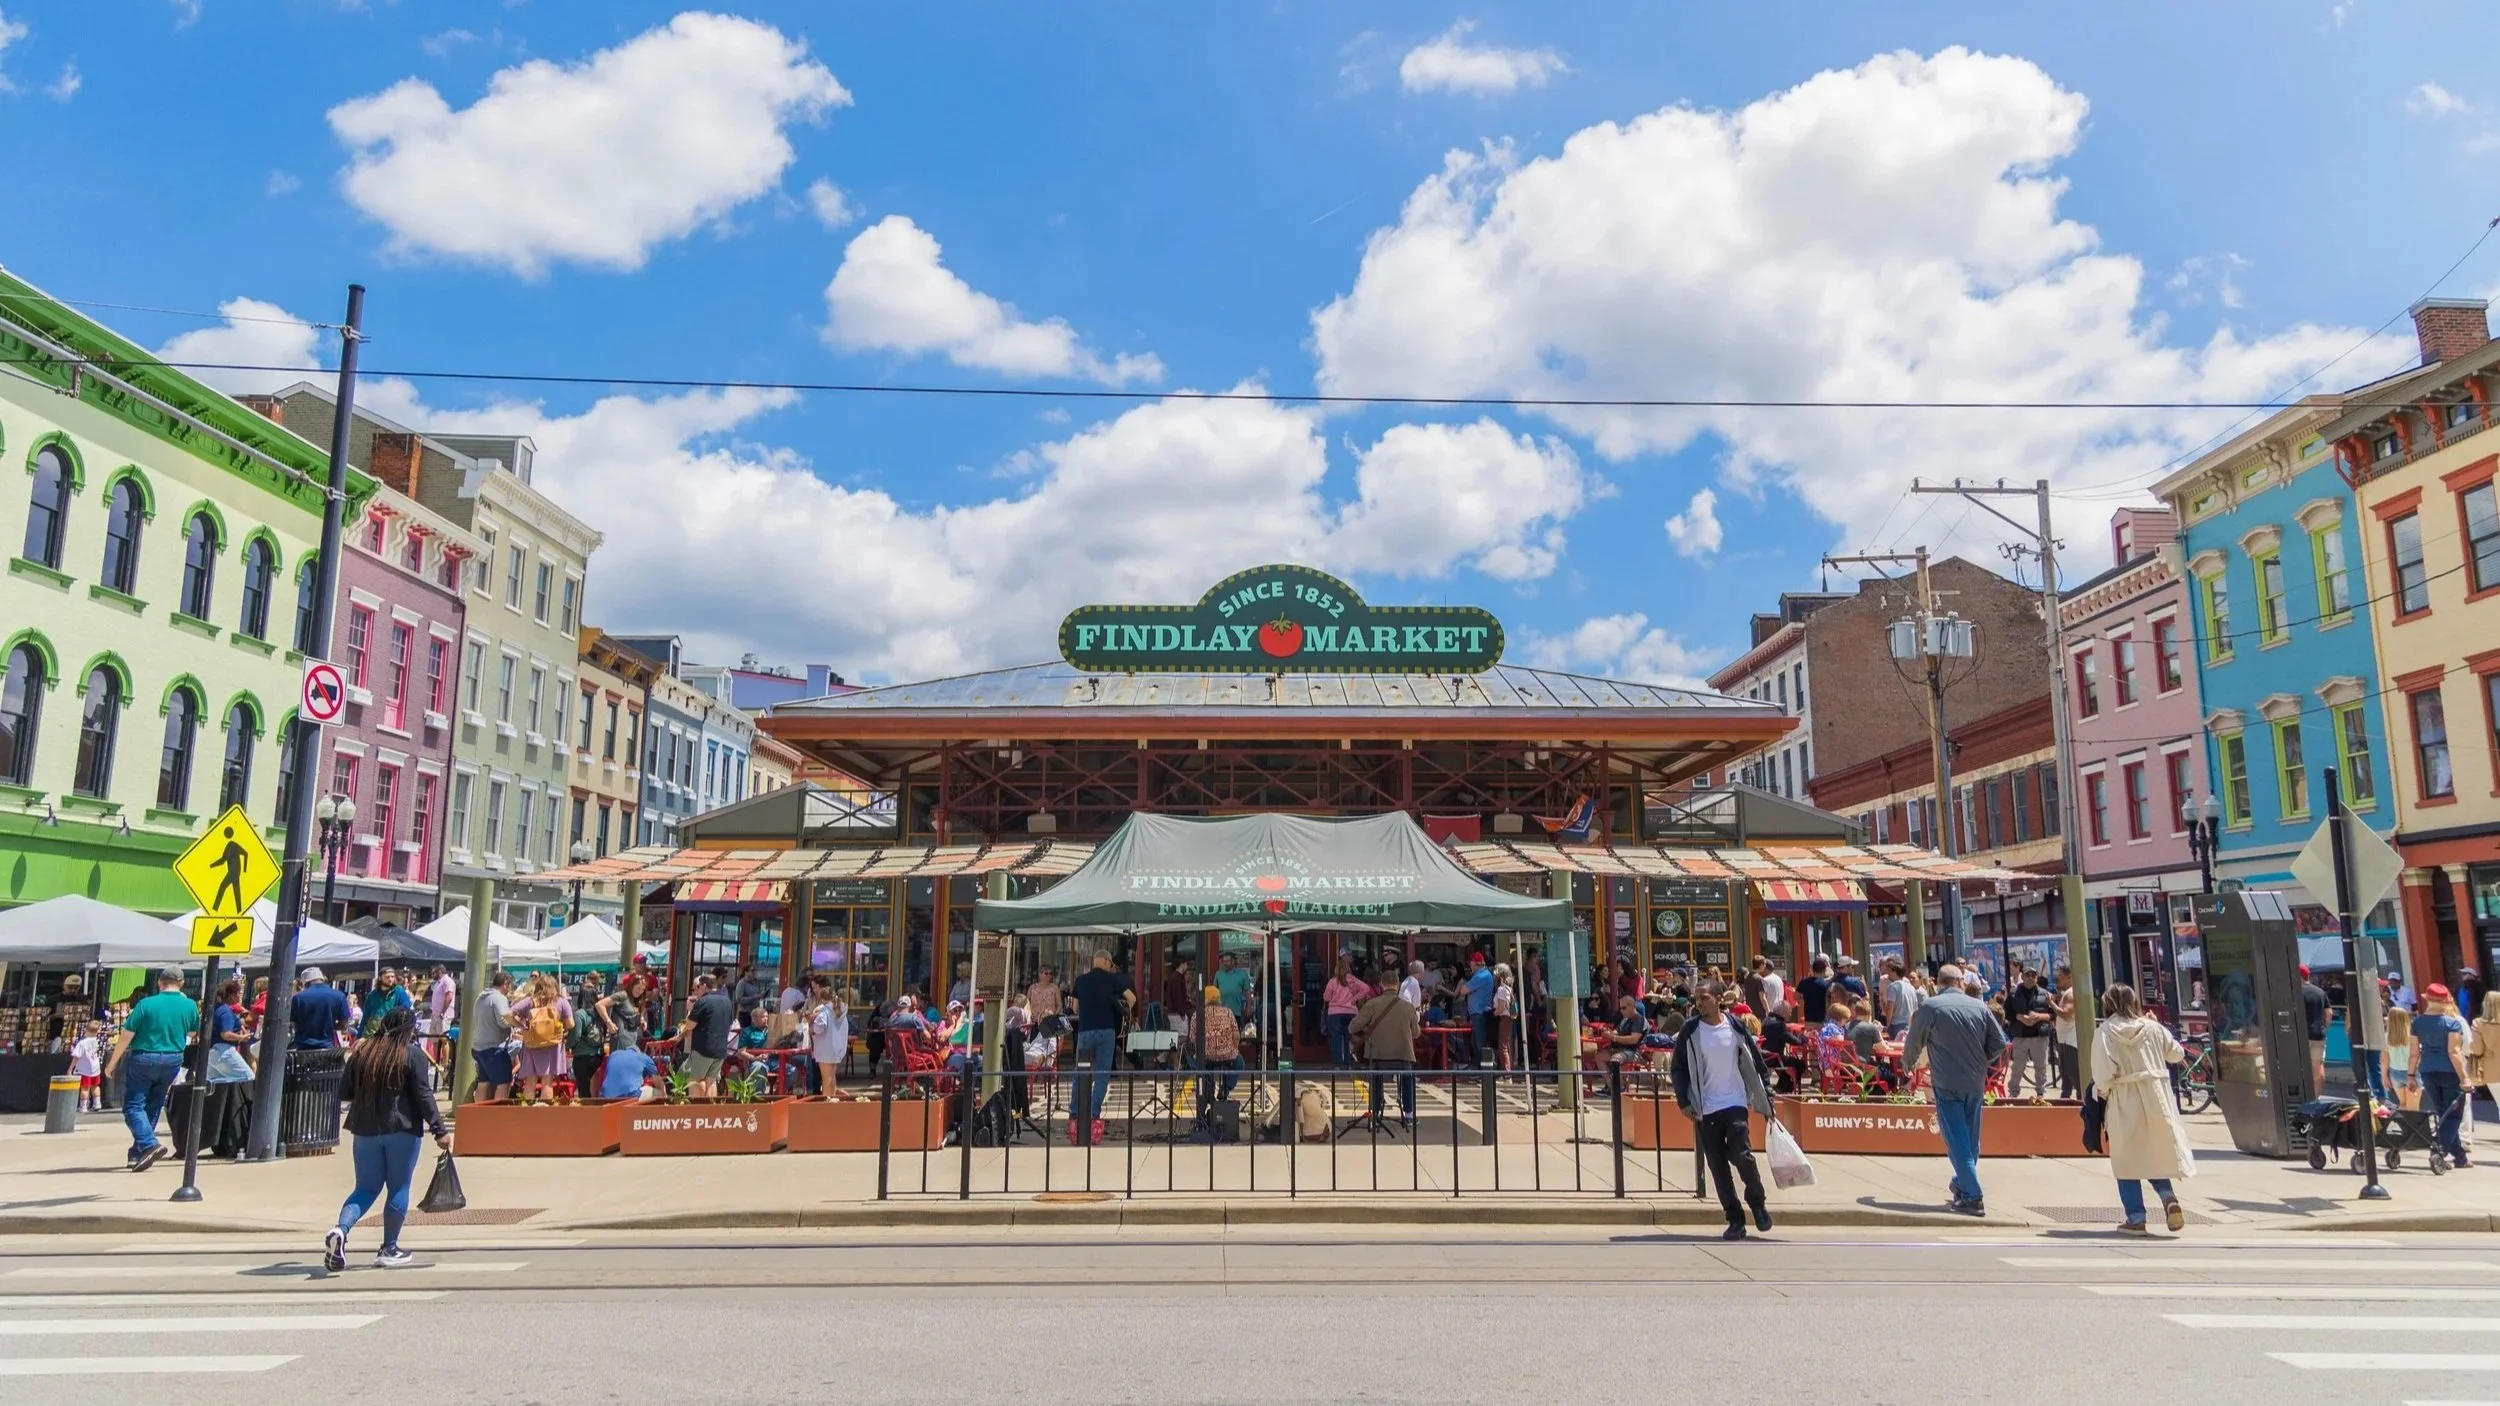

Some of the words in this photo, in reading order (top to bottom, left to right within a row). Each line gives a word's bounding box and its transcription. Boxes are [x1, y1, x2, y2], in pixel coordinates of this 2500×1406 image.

[1218, 581, 1284, 619] SINCE
[1295, 583, 1345, 619] 1852
[1075, 624, 1259, 652] FINDLAY
[1303, 626, 1488, 653] MARKET
[1235, 856, 1274, 875] SINCE
[1130, 876, 1258, 889] FINDLAY
[1286, 875, 1415, 889] MARKET
[1157, 901, 1261, 916] FINDLAY
[1286, 901, 1394, 916] MARKET
[633, 1118, 692, 1131] BUNNY'S
[696, 1117, 743, 1129] PLAZA
[1815, 1116, 1874, 1129] BUNNY'S
[1877, 1118, 1925, 1130] PLAZA
